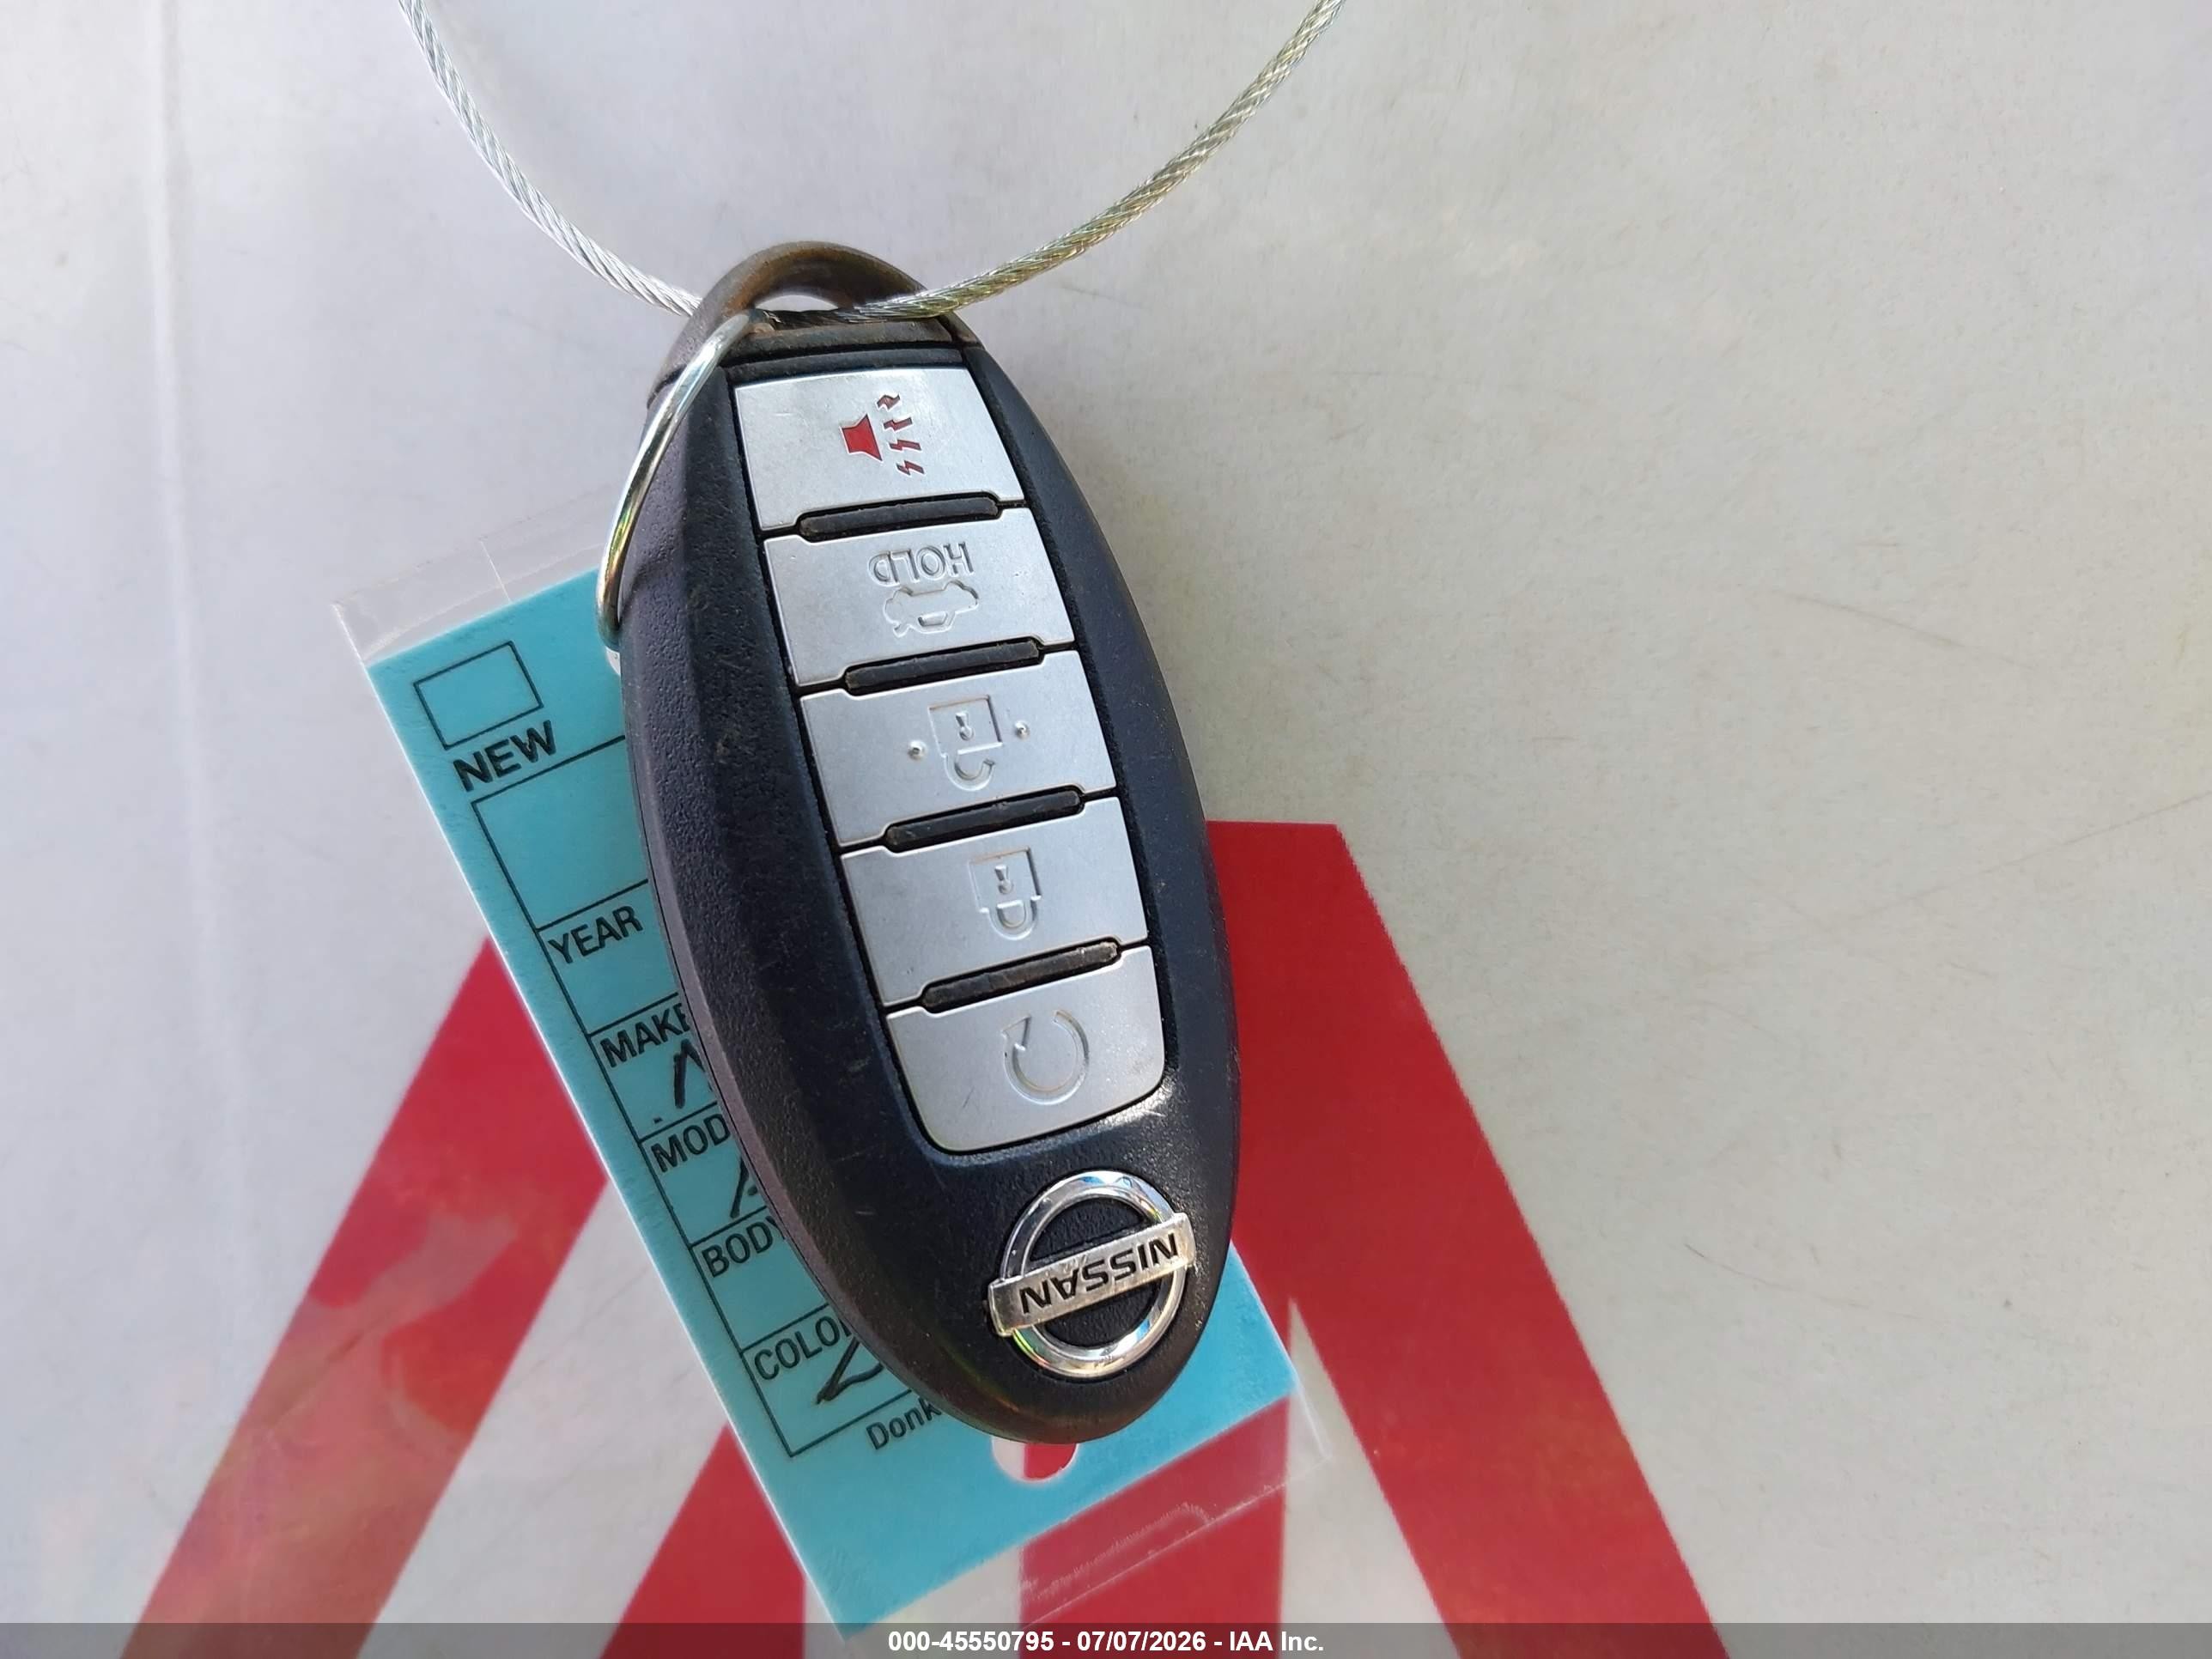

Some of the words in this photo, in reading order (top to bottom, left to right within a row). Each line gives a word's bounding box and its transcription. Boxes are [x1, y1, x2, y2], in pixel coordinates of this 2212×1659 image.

[867, 541, 975, 586] HOLD
[453, 720, 556, 792] NEW
[548, 905, 643, 964] YEAR
[1018, 1232, 1179, 1314] NISSAN
[754, 1316, 852, 1381] COLO
